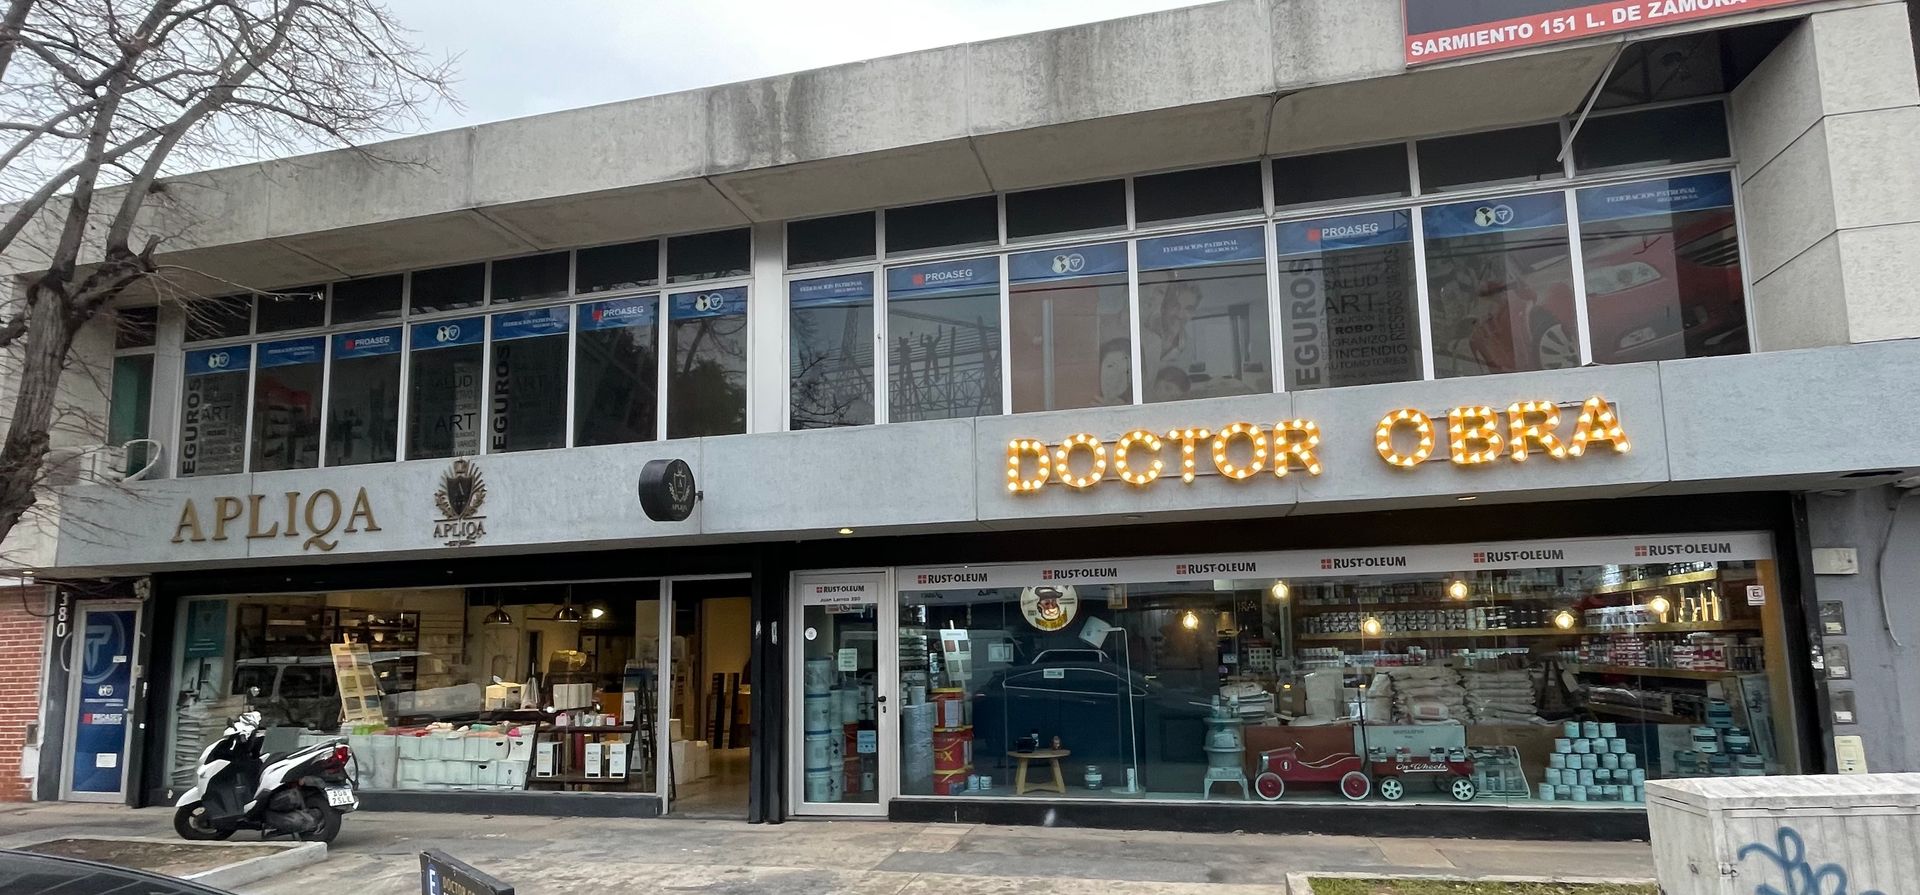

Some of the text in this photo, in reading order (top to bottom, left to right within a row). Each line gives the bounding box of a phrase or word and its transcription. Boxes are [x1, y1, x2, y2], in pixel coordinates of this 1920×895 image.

[1411, 0, 1747, 57] SARMIENTO 151 L. DE ZAMO
[1322, 222, 1379, 238] PROASEG
[925, 268, 973, 282] PROASEG
[1322, 274, 1379, 291] SALUD
[603, 305, 644, 318] PROASEG
[1321, 292, 1379, 315] ART
[1335, 324, 1374, 335] ROBO
[354, 336, 390, 348] PROASEG
[1332, 334, 1388, 347] GRANIZO
[1335, 343, 1408, 359] INCENDIO
[493, 344, 511, 449] EGUROS
[182, 378, 201, 475] EGUROS
[435, 413, 477, 433] ART
[1006, 396, 1632, 491] DOCTOR OBRA
[171, 486, 382, 551] APLIQA
[433, 520, 487, 540] APLIQA
[1486, 549, 1564, 563] RUST-OLEUM
[1649, 542, 1732, 556] RUST-OLEUM
[1188, 562, 1257, 575] RUST-OLEUM
[1333, 556, 1407, 570] RUST-OLEUM
[928, 573, 988, 584] RUST-OLEUM
[1053, 568, 1118, 580] RUST-OLEUM
[823, 585, 866, 593] RUST-OLEUM
[56, 592, 68, 638] 380
[429, 868, 436, 895] E
